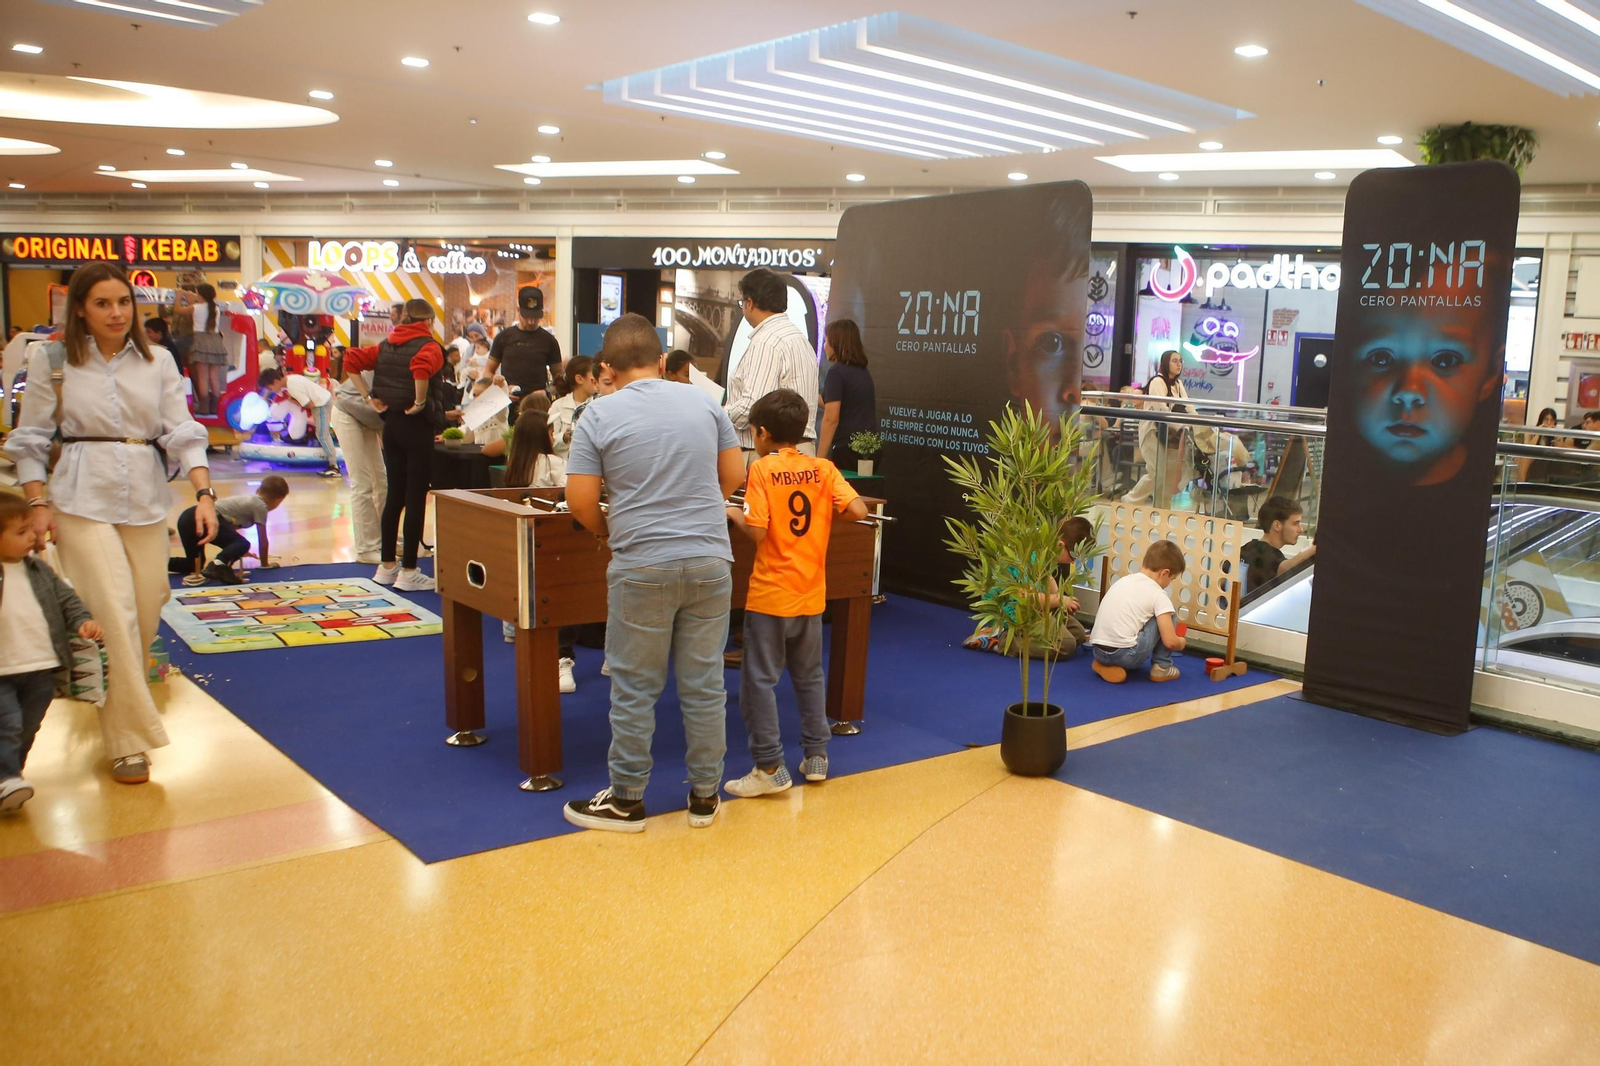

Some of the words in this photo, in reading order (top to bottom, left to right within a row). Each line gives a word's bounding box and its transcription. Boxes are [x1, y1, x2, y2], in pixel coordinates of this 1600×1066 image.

[13, 236, 118, 261] ORIGINAL
[141, 238, 219, 262] KEBAB
[308, 240, 399, 273] LOOPS
[403, 248, 420, 273] &
[427, 251, 487, 275] coffee
[652, 246, 691, 267] 100
[1362, 240, 1486, 289] ZO:NA
[1360, 295, 1395, 307] CERO
[1400, 295, 1482, 307] PANTALLAS
[897, 290, 981, 336] ZO:NA
[896, 341, 920, 353] CERO
[923, 341, 977, 354] PANTALLAS
[889, 406, 916, 418] VUELVE
[918, 409, 924, 419] A
[926, 410, 951, 421] JUGAR
[953, 413, 959, 422] A
[961, 413, 973, 424] LO
[881, 418, 890, 428] DE
[892, 420, 923, 432] SIEMPRE
[925, 424, 949, 435] COMO
[951, 427, 979, 439] NUNCA
[899, 435, 925, 446] HECHO
[927, 437, 943, 448] CON
[945, 440, 960, 451] LOS
[963, 442, 989, 454] TUYOS
[788, 490, 811, 537] 9
